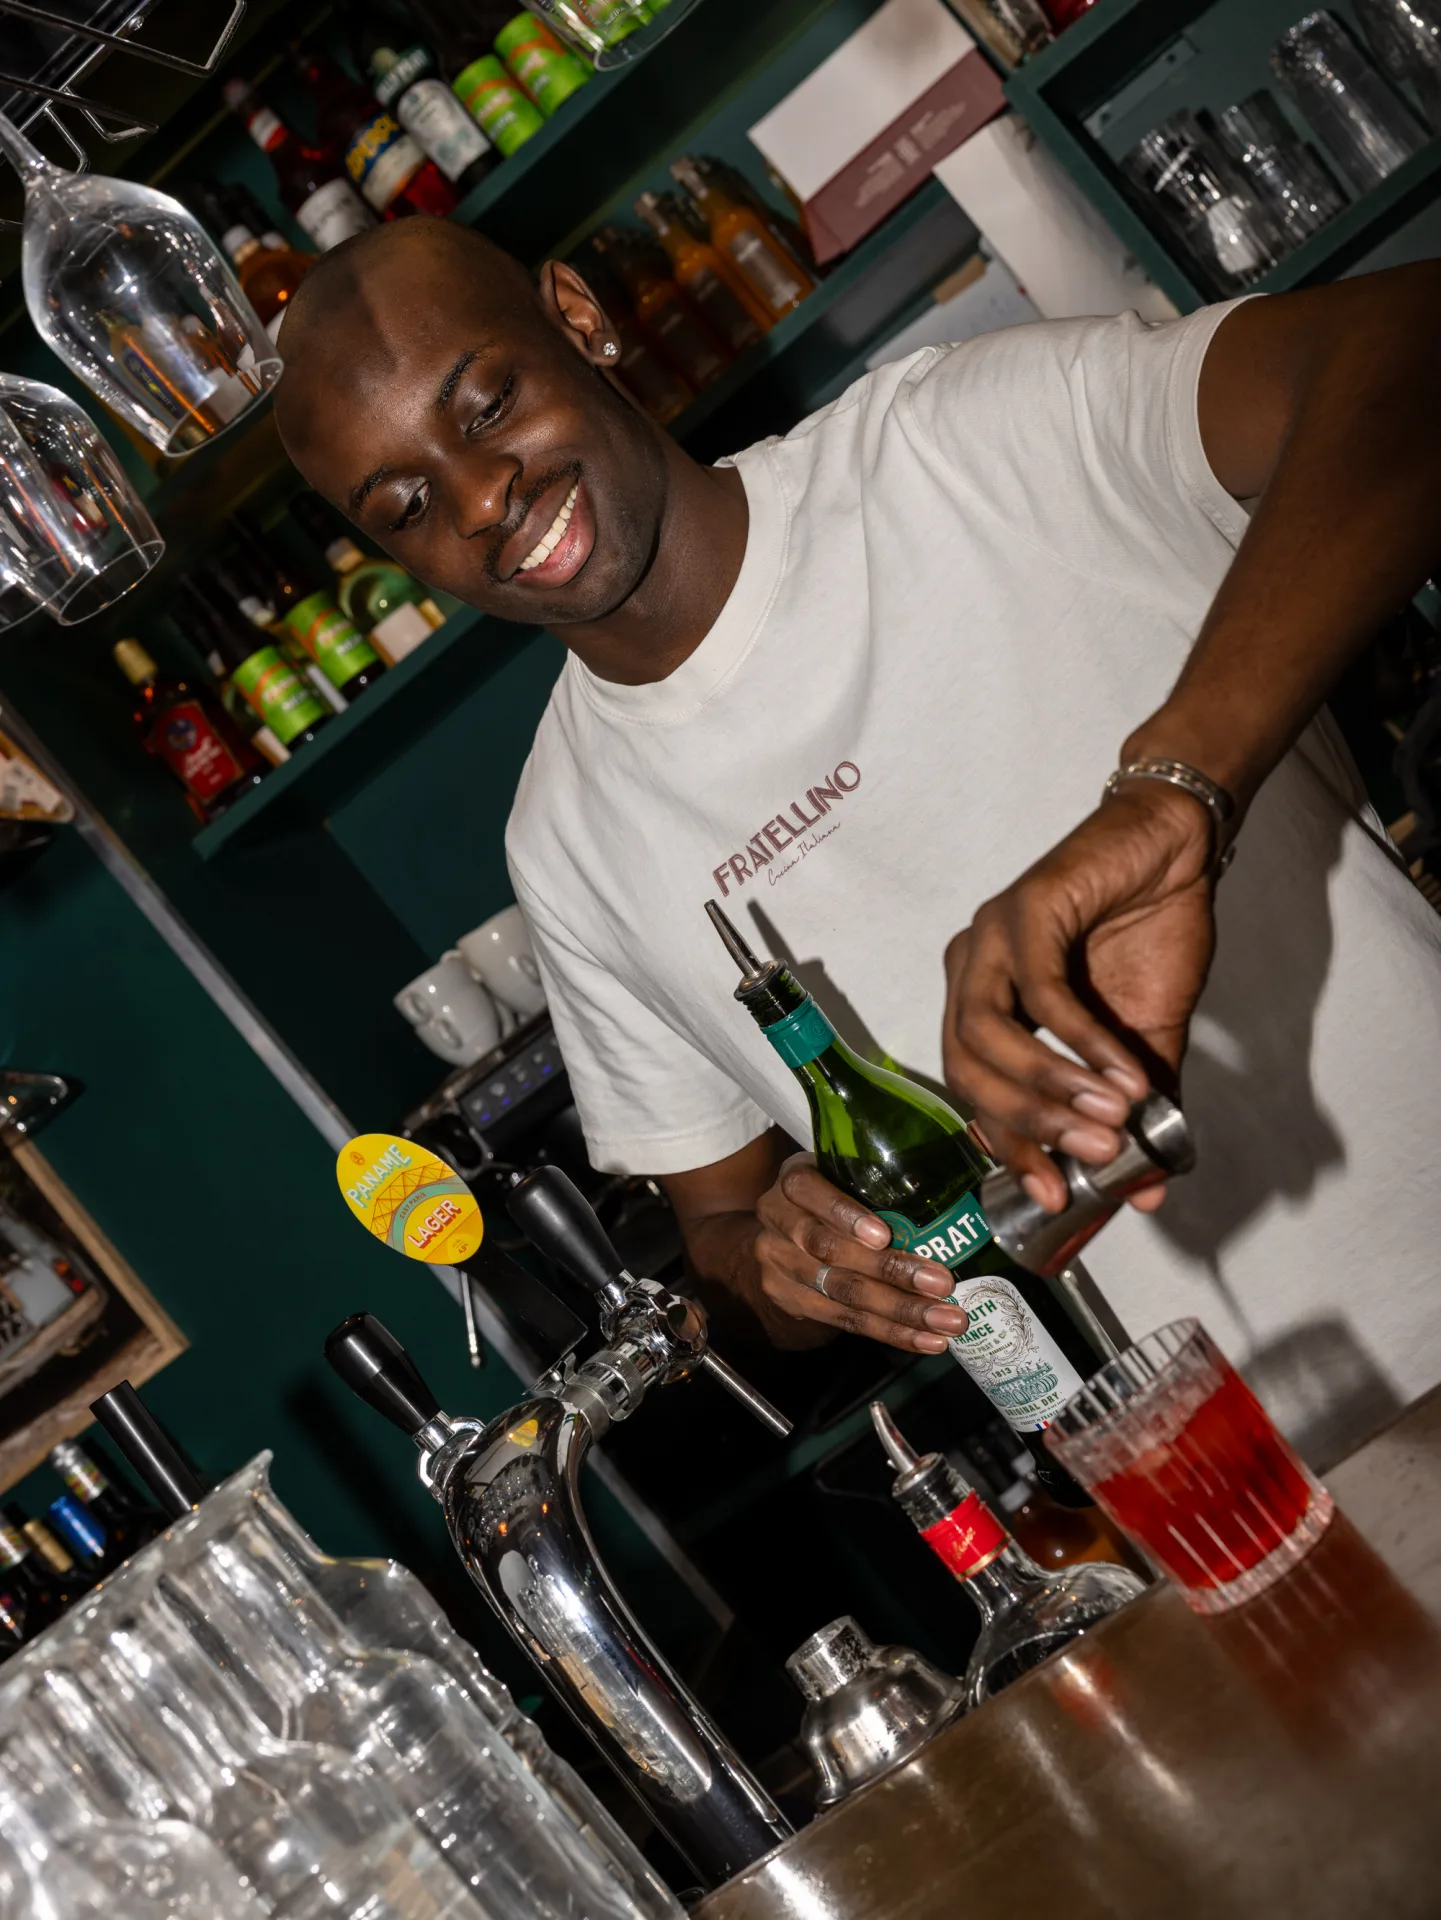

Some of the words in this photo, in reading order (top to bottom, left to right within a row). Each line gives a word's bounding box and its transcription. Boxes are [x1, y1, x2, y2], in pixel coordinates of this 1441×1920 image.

[712, 761, 861, 897] FRATELLINO
[797, 822, 841, 859] Italiana
[346, 1143, 412, 1208] PANAME
[400, 1205, 410, 1219] EAST
[409, 1192, 427, 1206] PARIS
[407, 1199, 461, 1249] LAGER
[914, 1213, 979, 1262] PRAT
[952, 1323, 994, 1345] FRANCE
[991, 1367, 1012, 1379] 1813
[1005, 1403, 1040, 1416] ORIGINAL
[1041, 1391, 1060, 1407] DRY
